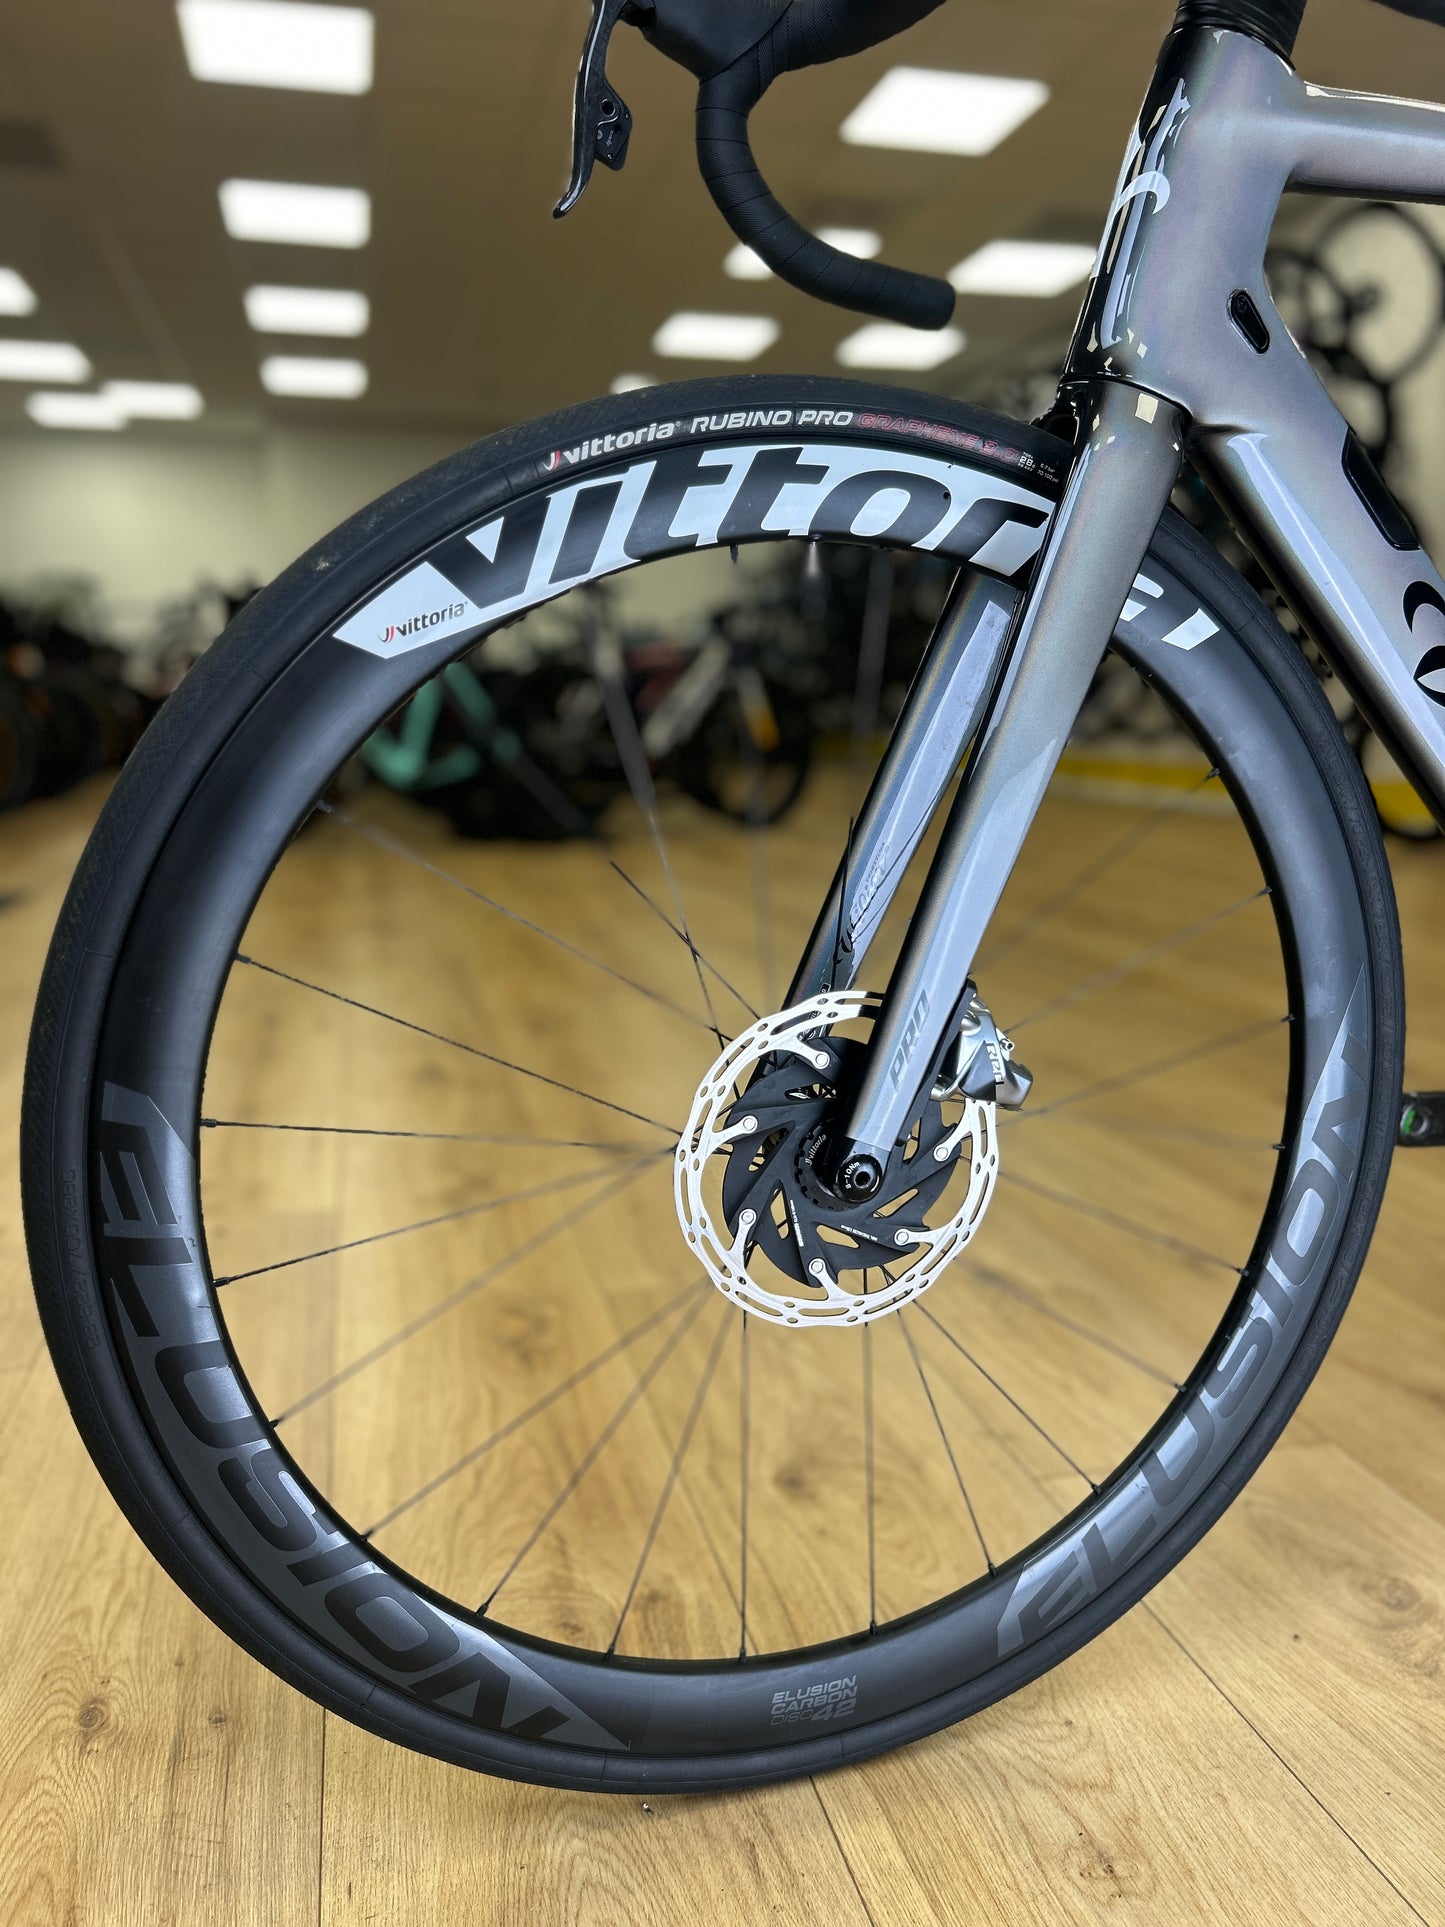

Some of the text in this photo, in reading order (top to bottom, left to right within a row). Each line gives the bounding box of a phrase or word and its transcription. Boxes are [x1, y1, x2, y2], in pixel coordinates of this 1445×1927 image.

[564, 410, 1020, 466] vittoria RUBINO PRO GRAPHENE 2.0
[395, 602, 465, 637] vittoria
[1015, 1035, 1368, 1648] ELUSION
[100, 1119, 571, 1738] ELUSION
[771, 1685, 858, 1715] CARBON
[772, 1674, 857, 1704] ELUSION
